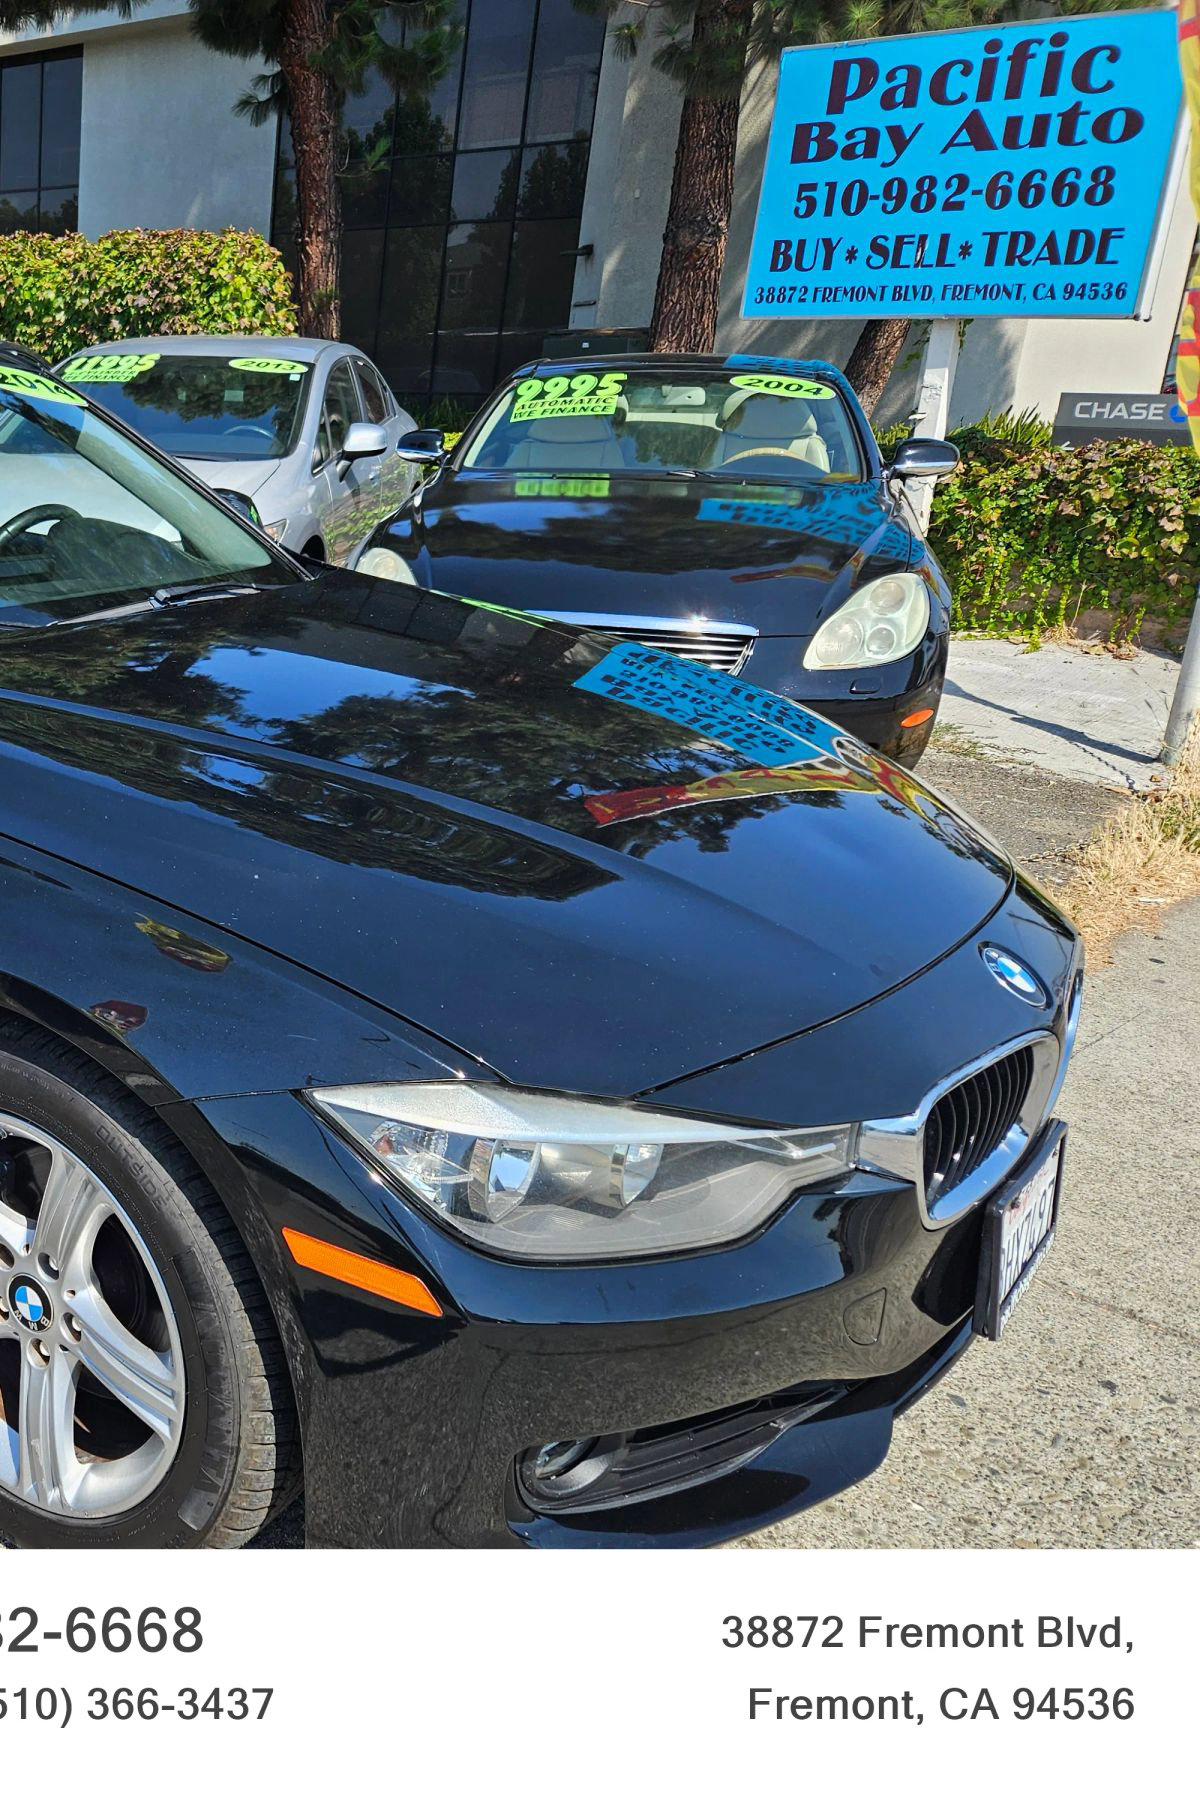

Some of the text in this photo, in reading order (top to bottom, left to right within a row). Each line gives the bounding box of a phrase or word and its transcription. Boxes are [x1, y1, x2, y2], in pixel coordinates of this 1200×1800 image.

[826, 31, 1121, 116] Pacific
[790, 100, 1145, 168] Bay Auto
[793, 165, 1116, 219] 510-982-6668
[769, 227, 1125, 273] BUY SELL TRADE
[754, 282, 1127, 305] 38872 FREMONT BLVD, FREMONT, CA 94536
[240, 360, 298, 371] 2013
[517, 373, 628, 402] 9995
[742, 378, 823, 396] 2004
[514, 405, 612, 420] WE FINANCE
[516, 396, 613, 411] AUTOMATIC
[1074, 402, 1167, 420] CHASE
